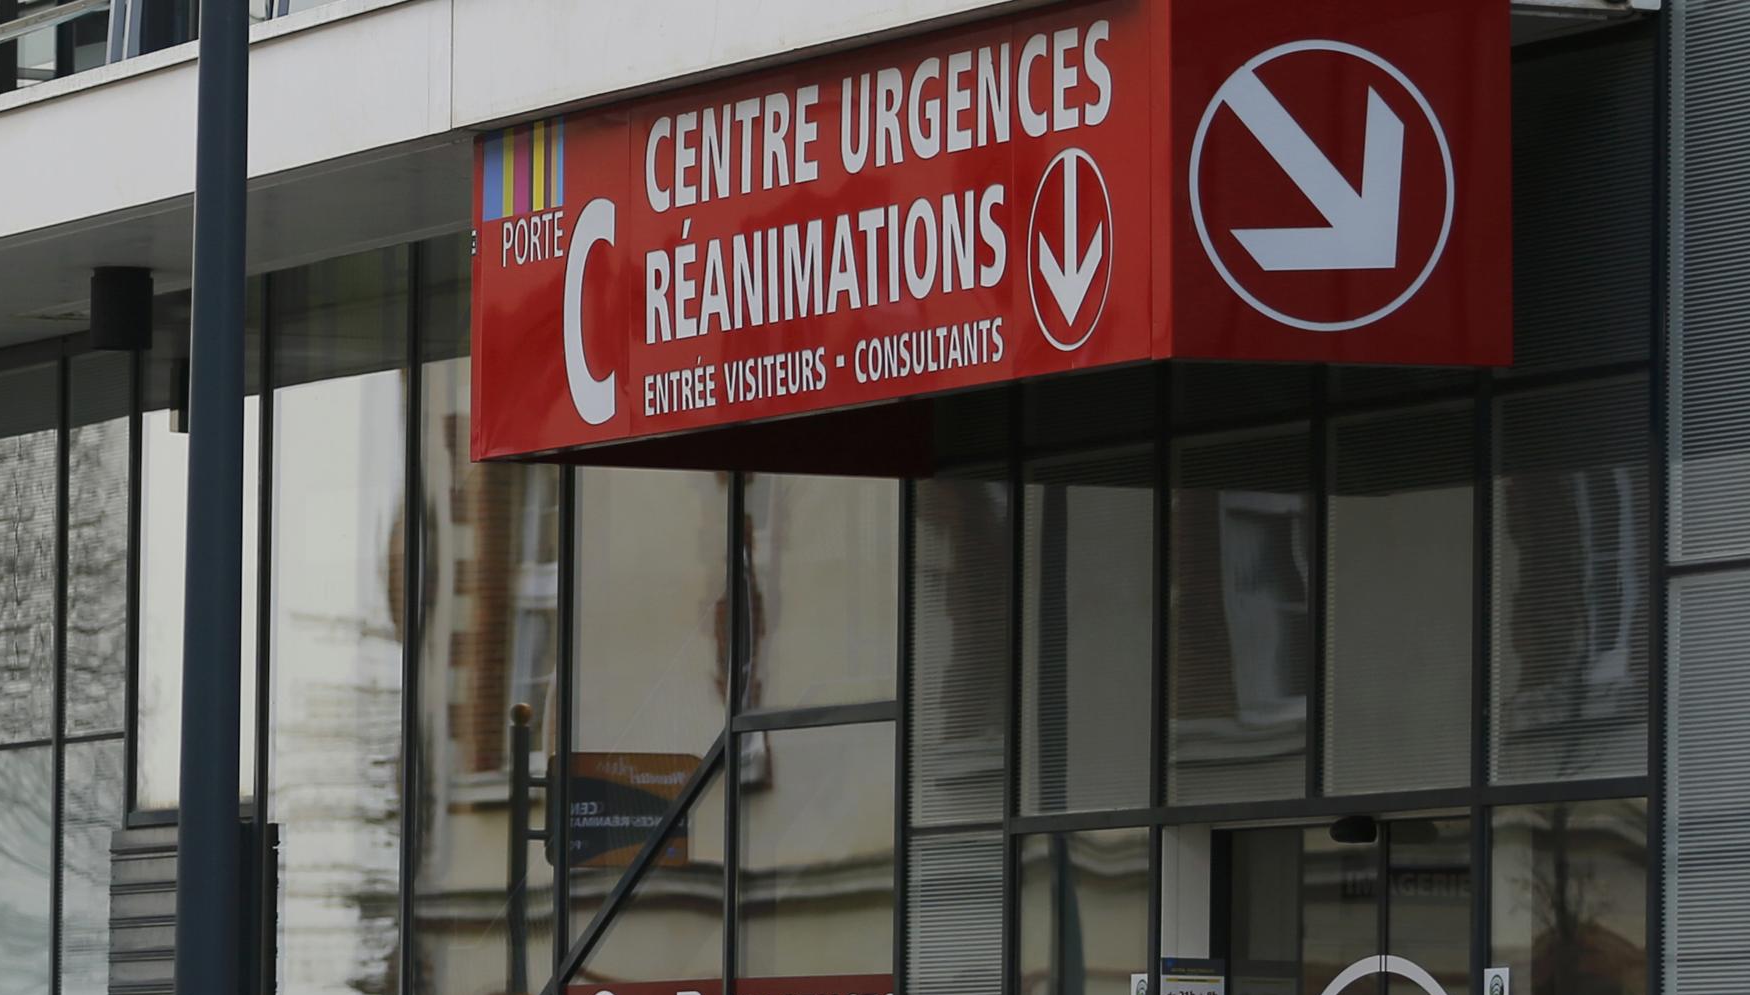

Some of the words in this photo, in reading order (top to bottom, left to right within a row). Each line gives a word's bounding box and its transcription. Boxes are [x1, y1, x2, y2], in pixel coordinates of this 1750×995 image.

[645, 84, 819, 214] CENTRE
[840, 20, 1112, 175] URGENCES
[501, 211, 565, 268] PORTE
[562, 197, 617, 425] C
[645, 184, 1008, 345] RÉANIMATIONS
[644, 355, 717, 417] ENTRÉE
[723, 347, 827, 404] VISITEURS
[853, 316, 1004, 384] CONSULTANTS
